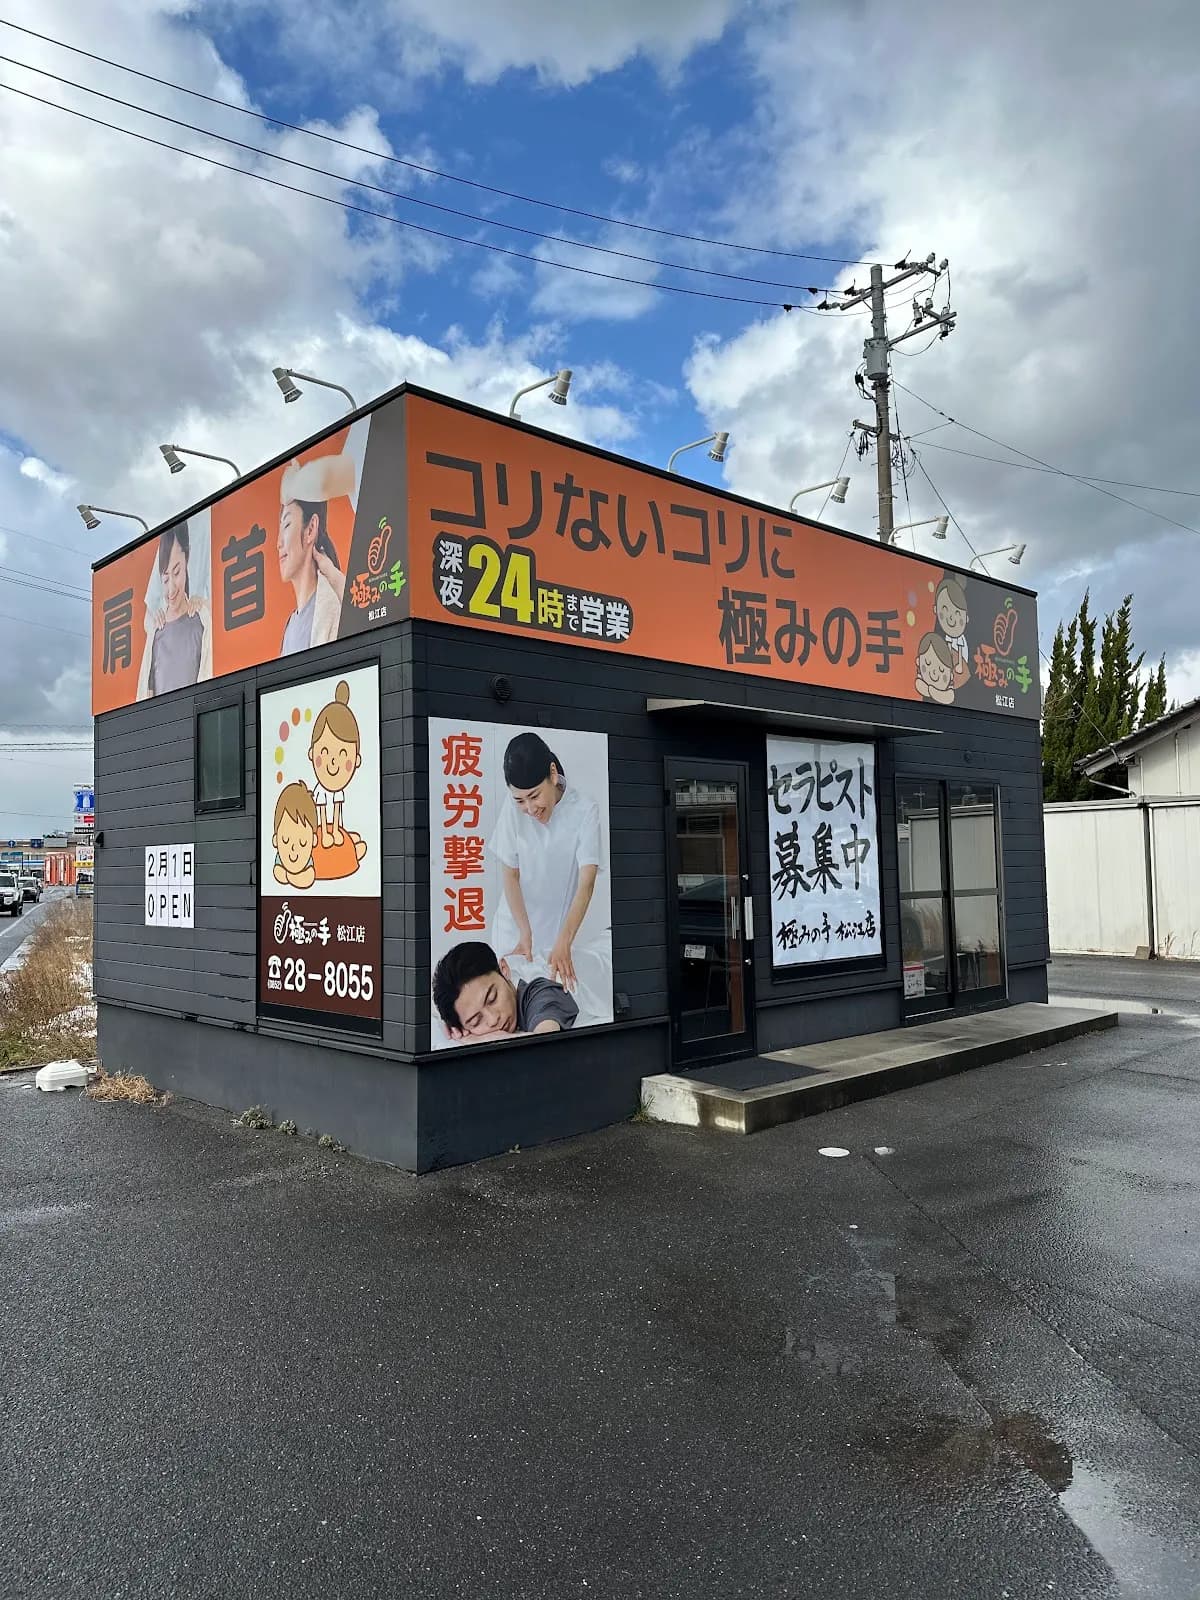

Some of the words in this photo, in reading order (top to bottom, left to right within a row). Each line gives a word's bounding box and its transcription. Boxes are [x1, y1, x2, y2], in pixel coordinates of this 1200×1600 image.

[426, 451, 795, 578] コリないコリに
[221, 524, 266, 631] 首
[102, 588, 133, 674] 肩
[718, 586, 903, 673] 極みの手
[767, 757, 873, 819] セラピスト
[148, 852, 192, 877] 2月1日
[441, 732, 486, 933] 疲労撃退
[772, 821, 871, 901] 募集中
[148, 893, 191, 918] OPEN
[337, 924, 366, 943] 松江店
[776, 911, 831, 951] 極みの手
[835, 909, 876, 941] 松江店
[284, 957, 374, 1001] 28-8055
